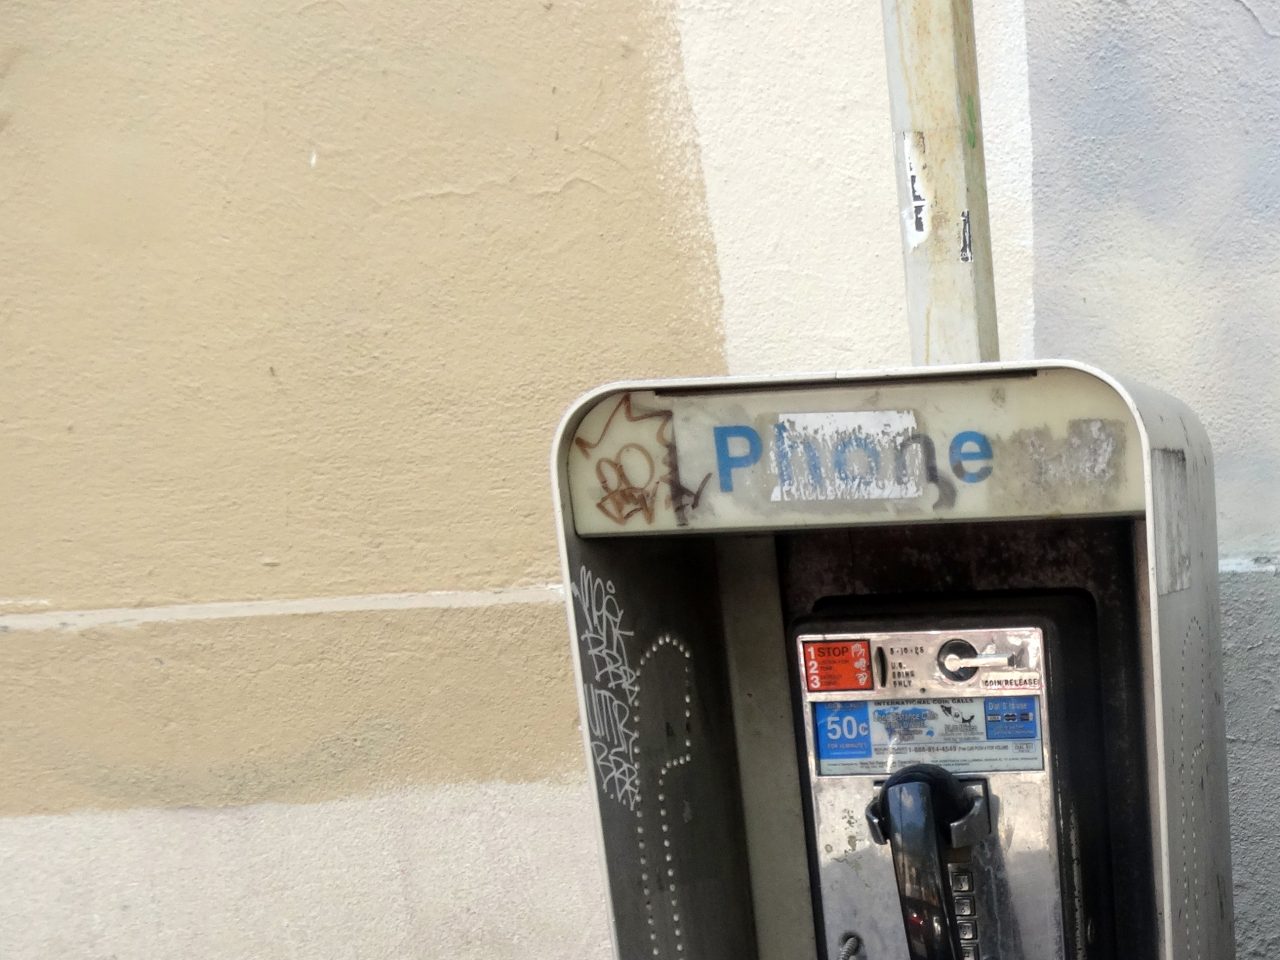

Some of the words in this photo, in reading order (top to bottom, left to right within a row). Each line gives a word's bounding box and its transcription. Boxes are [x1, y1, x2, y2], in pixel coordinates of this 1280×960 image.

[713, 421, 993, 493] Phone
[817, 646, 849, 658] STOP
[1004, 678, 1038, 687] RELEASE
[827, 716, 869, 740] 50¢
